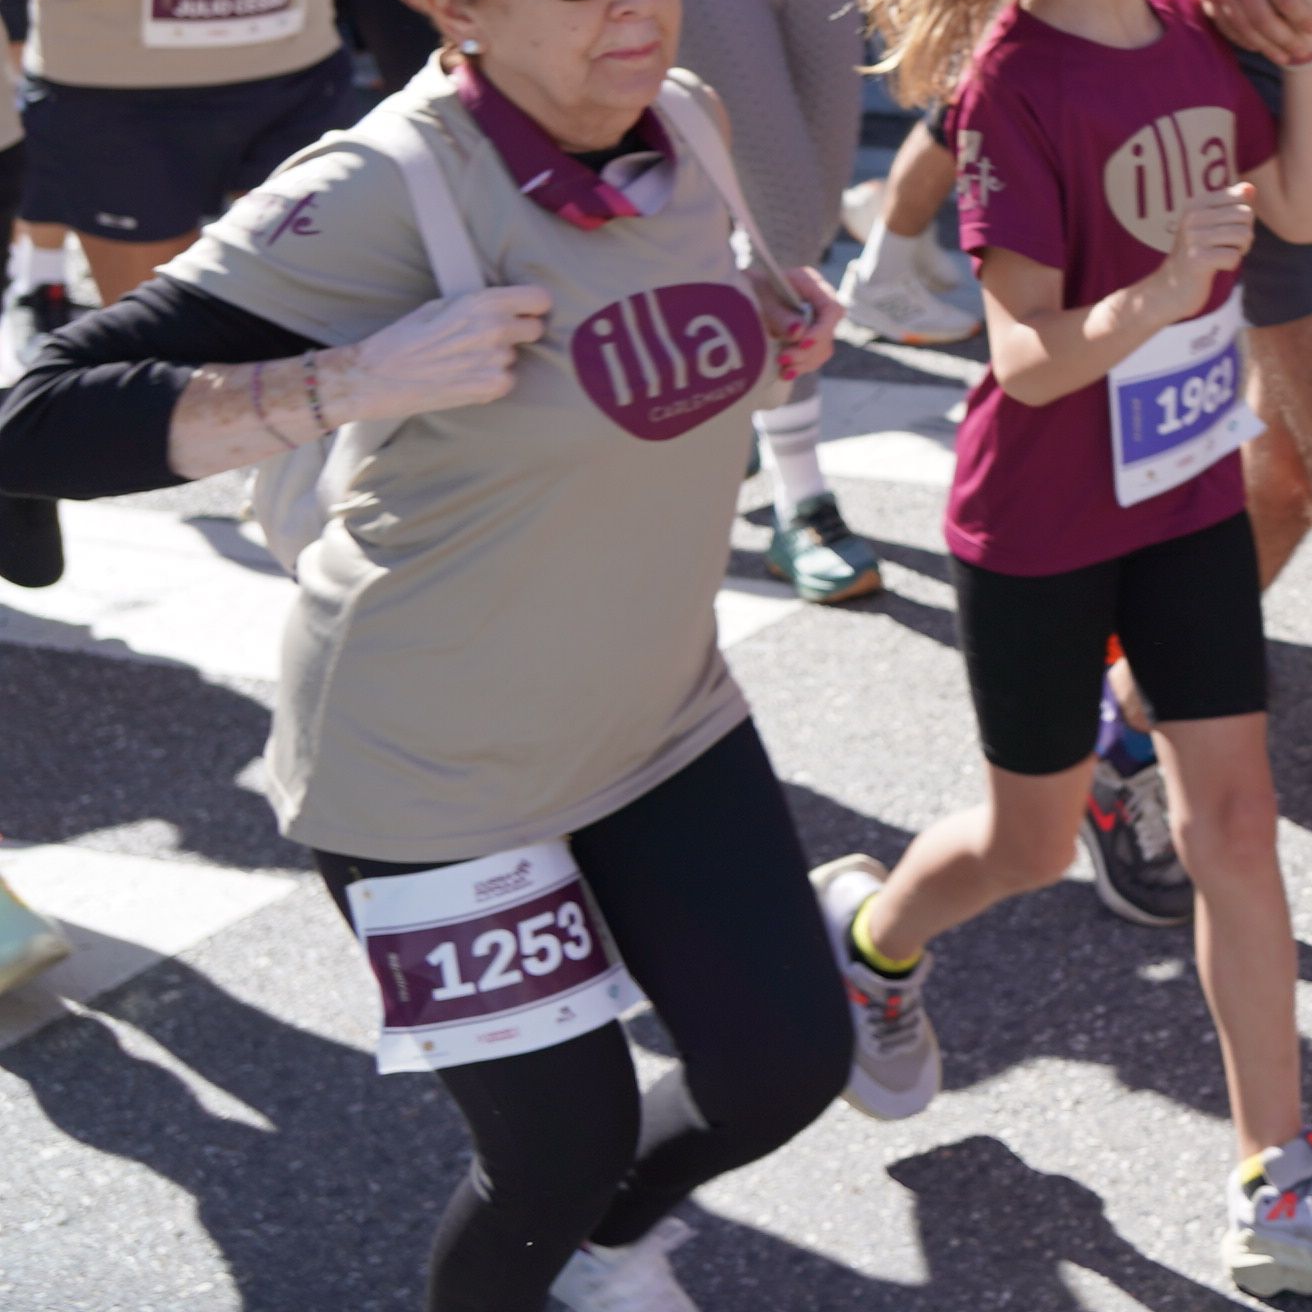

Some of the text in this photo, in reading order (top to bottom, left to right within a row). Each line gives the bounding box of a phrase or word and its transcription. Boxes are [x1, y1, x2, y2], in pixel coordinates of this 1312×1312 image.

[1132, 114, 1230, 219] illa
[593, 290, 743, 407] illa
[425, 901, 592, 1002] 1253
